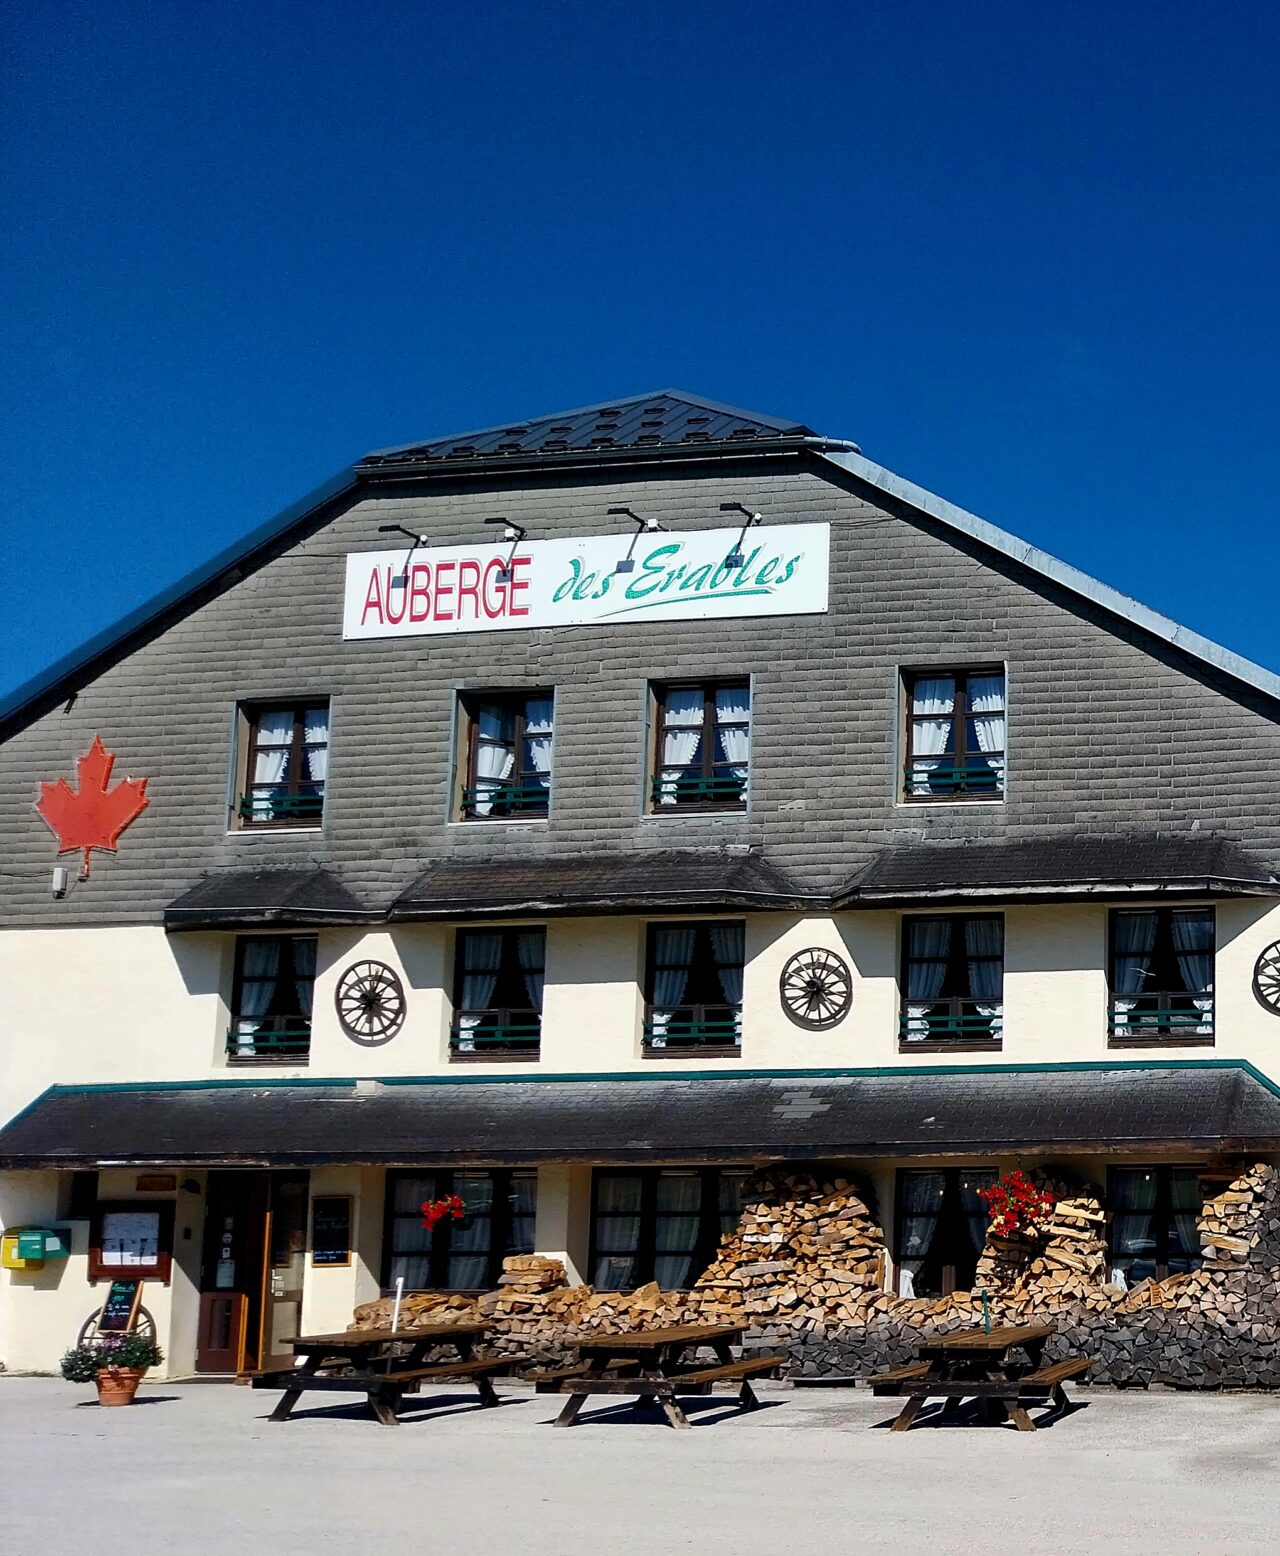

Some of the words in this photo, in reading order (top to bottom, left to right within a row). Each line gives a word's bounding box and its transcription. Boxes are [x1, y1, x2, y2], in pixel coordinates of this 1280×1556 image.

[361, 556, 533, 626] AUBERGE
[552, 558, 618, 603] des
[625, 542, 802, 600] Erables
